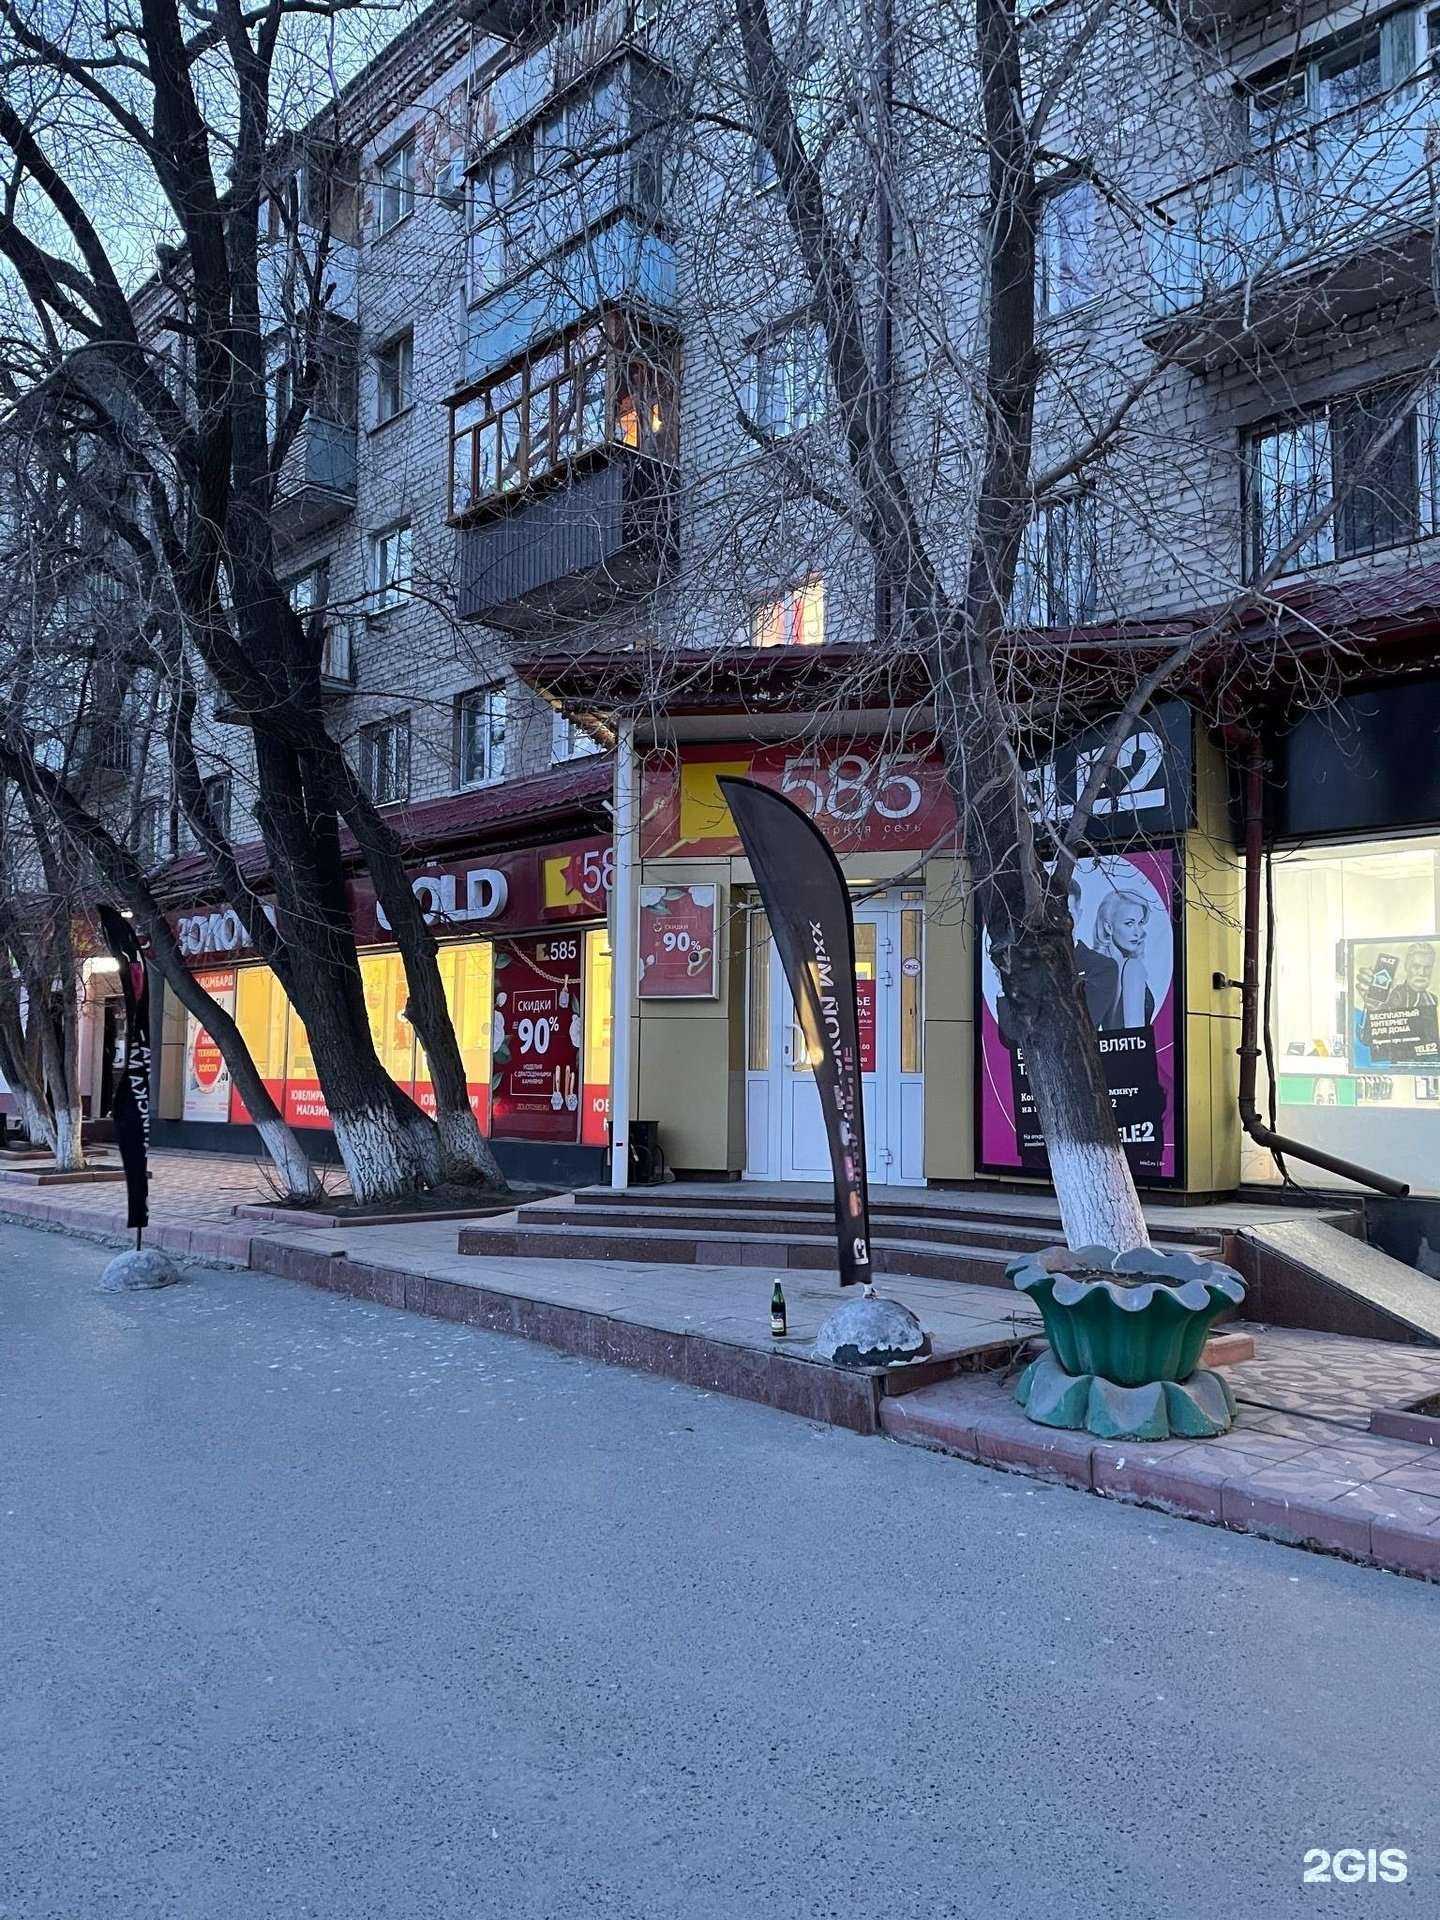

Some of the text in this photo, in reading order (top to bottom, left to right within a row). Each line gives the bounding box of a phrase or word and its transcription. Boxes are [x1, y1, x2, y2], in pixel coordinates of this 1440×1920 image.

[781, 754, 922, 821] 585
[550, 940, 577, 961] 585
[517, 999, 552, 1014] СКИДКИ
[1370, 1018, 1409, 1028] ИНТЕРНЕТ
[1371, 1026, 1411, 1036] ДЛЯ ДОМА
[1099, 1036, 1147, 1053] ВЛЯТЬ
